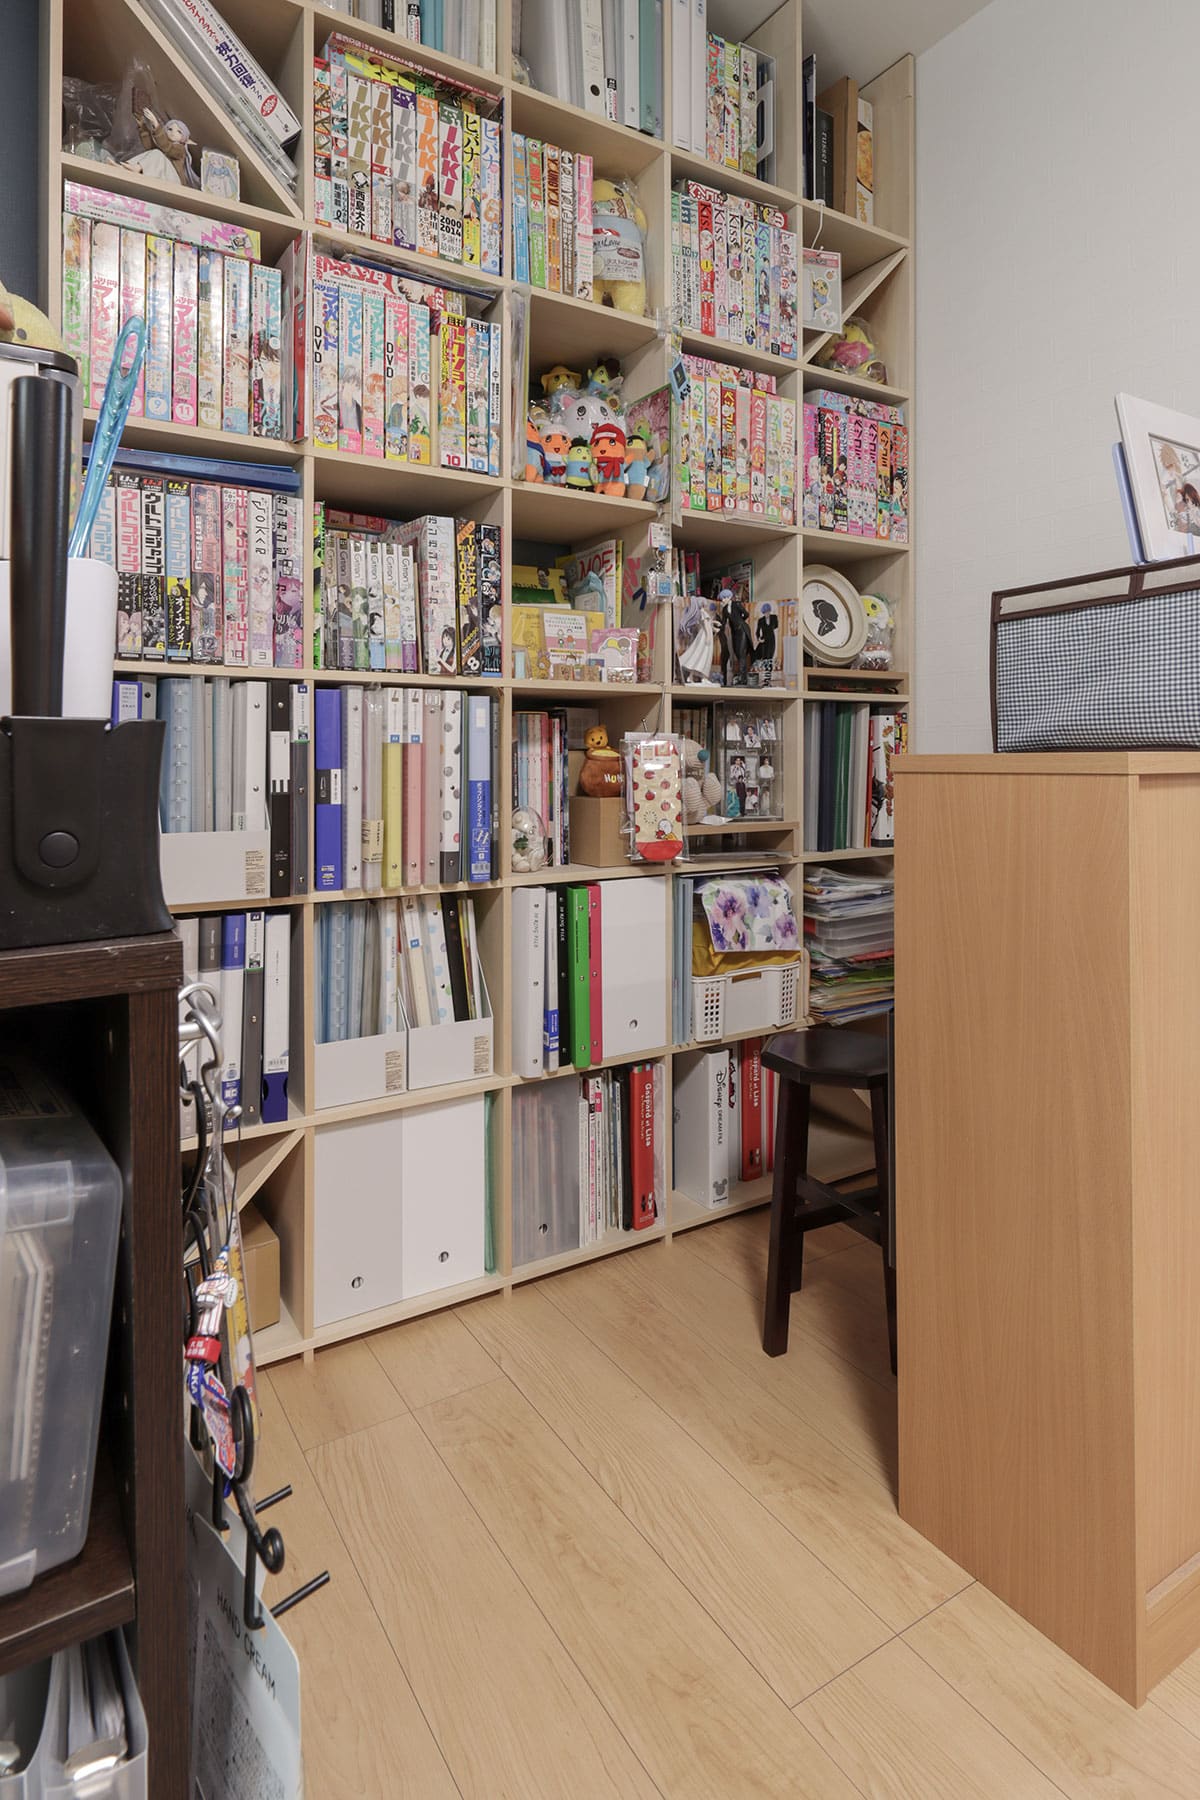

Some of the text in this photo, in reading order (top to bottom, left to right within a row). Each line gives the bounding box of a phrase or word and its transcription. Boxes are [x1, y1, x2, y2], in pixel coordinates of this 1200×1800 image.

[350, 85, 370, 159] IKKI
[407, 101, 416, 112] 6
[372, 91, 392, 165] IKKI
[394, 108, 416, 183] IKKI
[464, 115, 480, 163] ヒバナ
[483, 121, 499, 171] ヒバナ
[418, 117, 438, 188] IKKI
[441, 125, 461, 196] IKKI
[384, 168, 392, 178] 4
[355, 189, 366, 231] 西島大介
[578, 159, 593, 225] コーラス
[440, 215, 462, 229] 2000
[440, 223, 462, 237] 2014
[714, 207, 726, 242] Kiss
[729, 213, 741, 246] Kiss
[744, 220, 756, 254] Kiss
[682, 246, 691, 256] 10
[447, 316, 466, 329] 月刊
[471, 322, 490, 334] 月刊
[314, 326, 322, 363] DVD
[386, 341, 394, 379] DVD
[178, 405, 190, 416] 11
[754, 400, 766, 440] ベツコミ
[854, 419, 863, 460] ベツコミ
[869, 423, 878, 463] ベツコミ
[880, 430, 889, 467] ベツコミ
[446, 454, 461, 467] 10
[470, 458, 486, 471] 10
[693, 495, 704, 506] 10
[710, 496, 719, 507] 11
[120, 489, 140, 573] ウルトラジャンプ
[144, 492, 164, 575] ウルトラジャンプ
[169, 496, 188, 578] ウルトラジャンプ
[579, 549, 614, 582] MOE
[175, 596, 186, 641] オノ・ナツメ
[156, 643, 164, 651] 6
[177, 641, 192, 656] 11
[201, 637, 216, 651] 12
[468, 657, 480, 672] 8
[644, 1083, 653, 1119] Gaspard
[713, 1066, 728, 1109] Disney
[644, 1128, 653, 1148] Lisa
[216, 1587, 278, 1700] HAND CREAM
